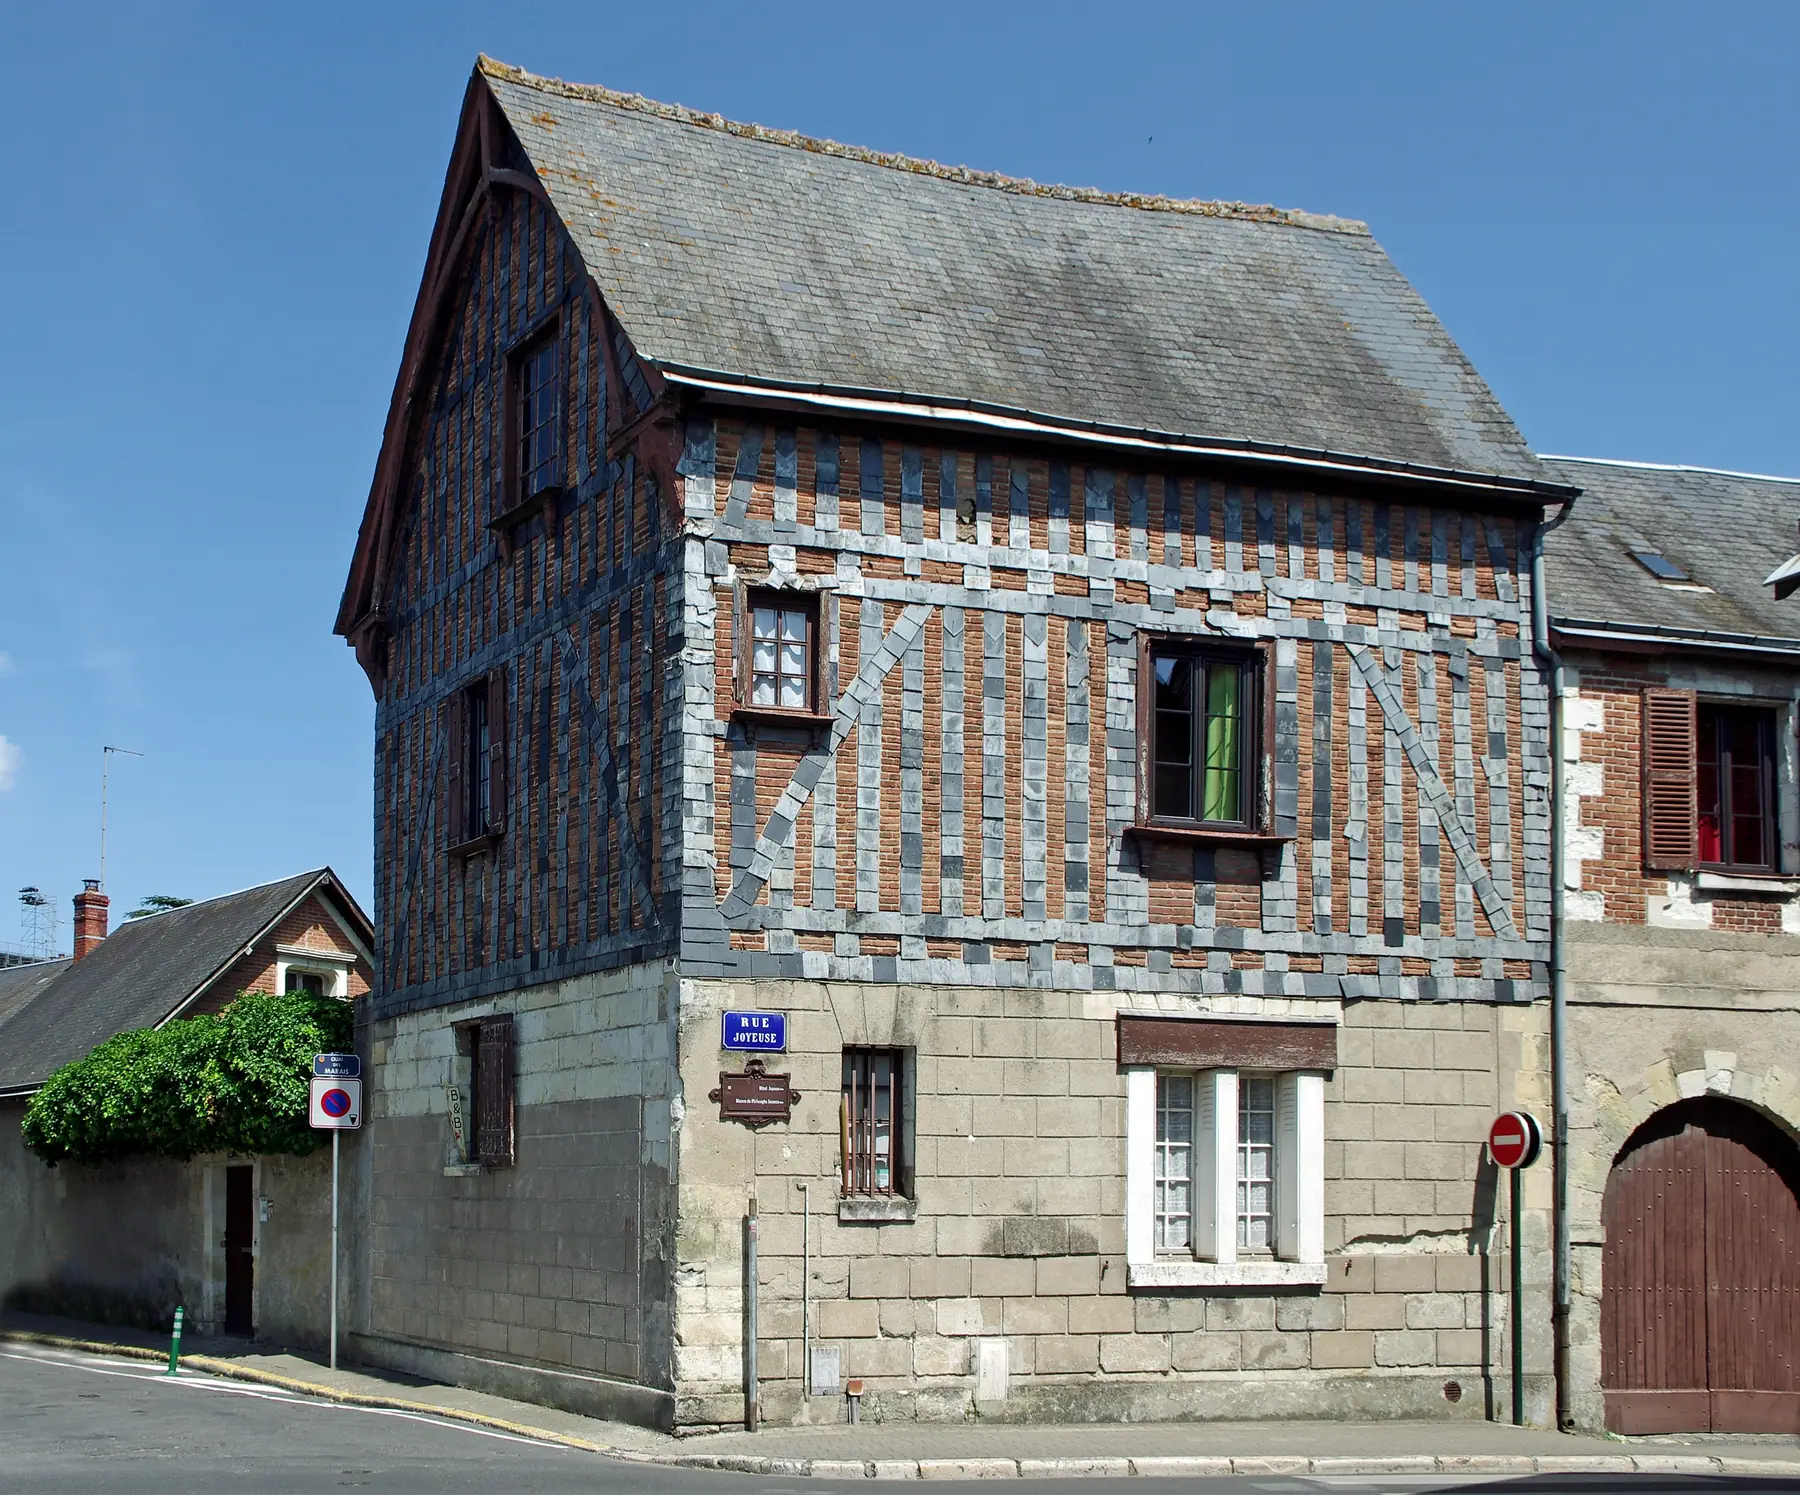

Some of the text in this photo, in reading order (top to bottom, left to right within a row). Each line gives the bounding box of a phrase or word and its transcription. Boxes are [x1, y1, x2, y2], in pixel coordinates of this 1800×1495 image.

[741, 1017, 769, 1028] RUE
[733, 1032, 777, 1043] JOYEUSE
[324, 1067, 349, 1075] MARAIS
